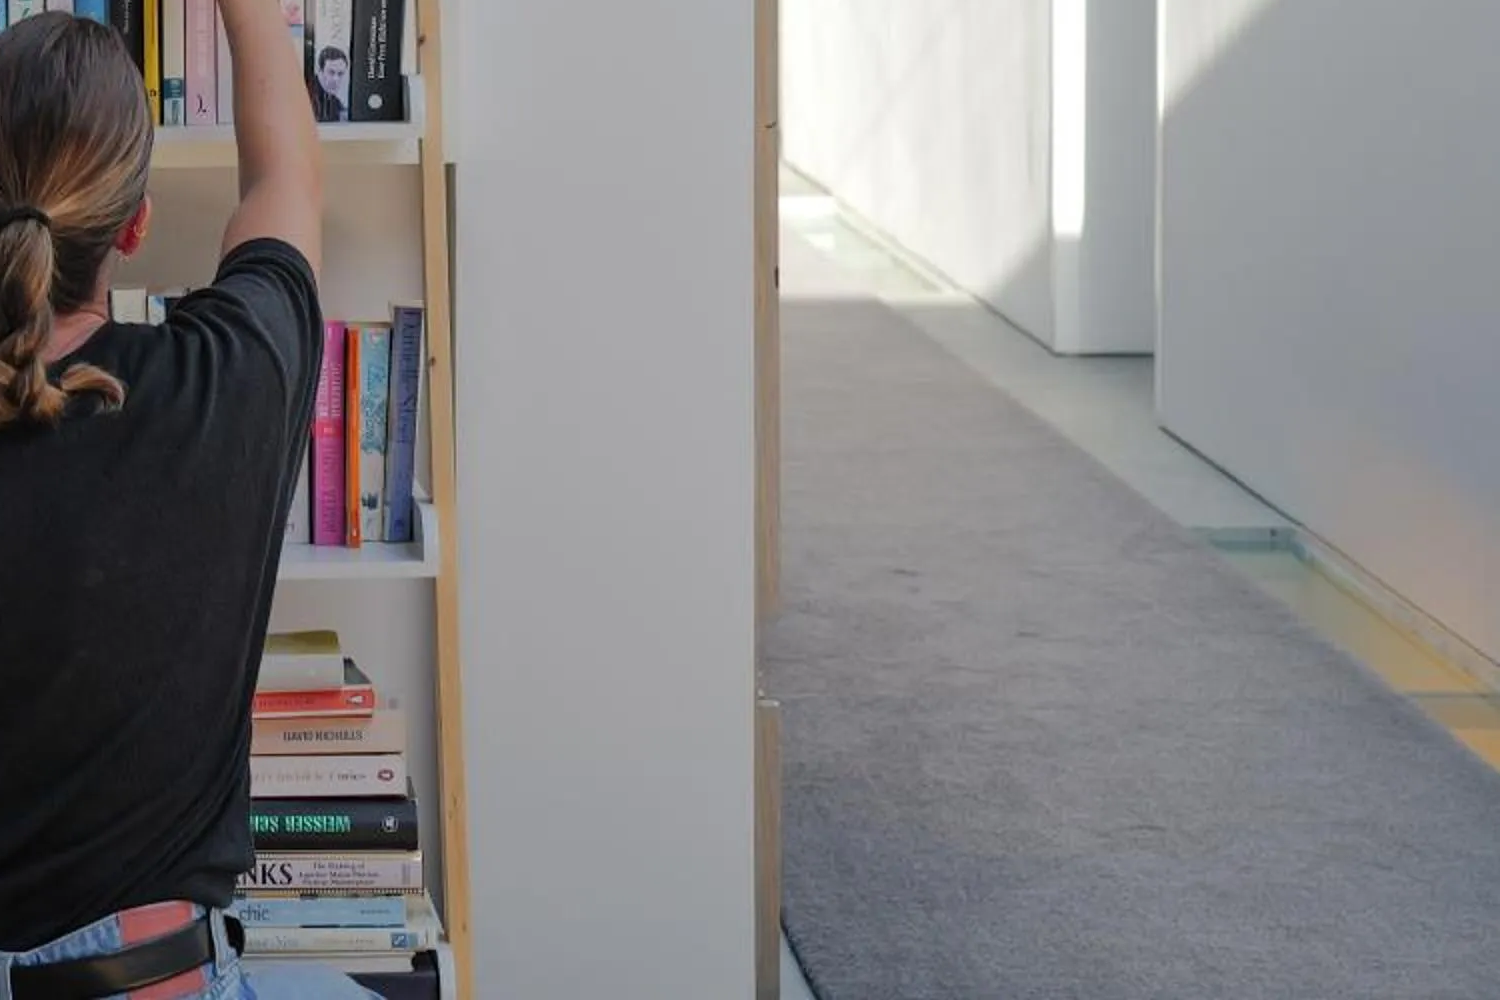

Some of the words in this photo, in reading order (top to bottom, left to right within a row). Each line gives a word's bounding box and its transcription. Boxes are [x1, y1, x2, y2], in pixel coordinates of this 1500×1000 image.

[283, 731, 313, 742] DAVID
[315, 730, 363, 742] NICHOLLS
[285, 815, 351, 833] WEISSER
